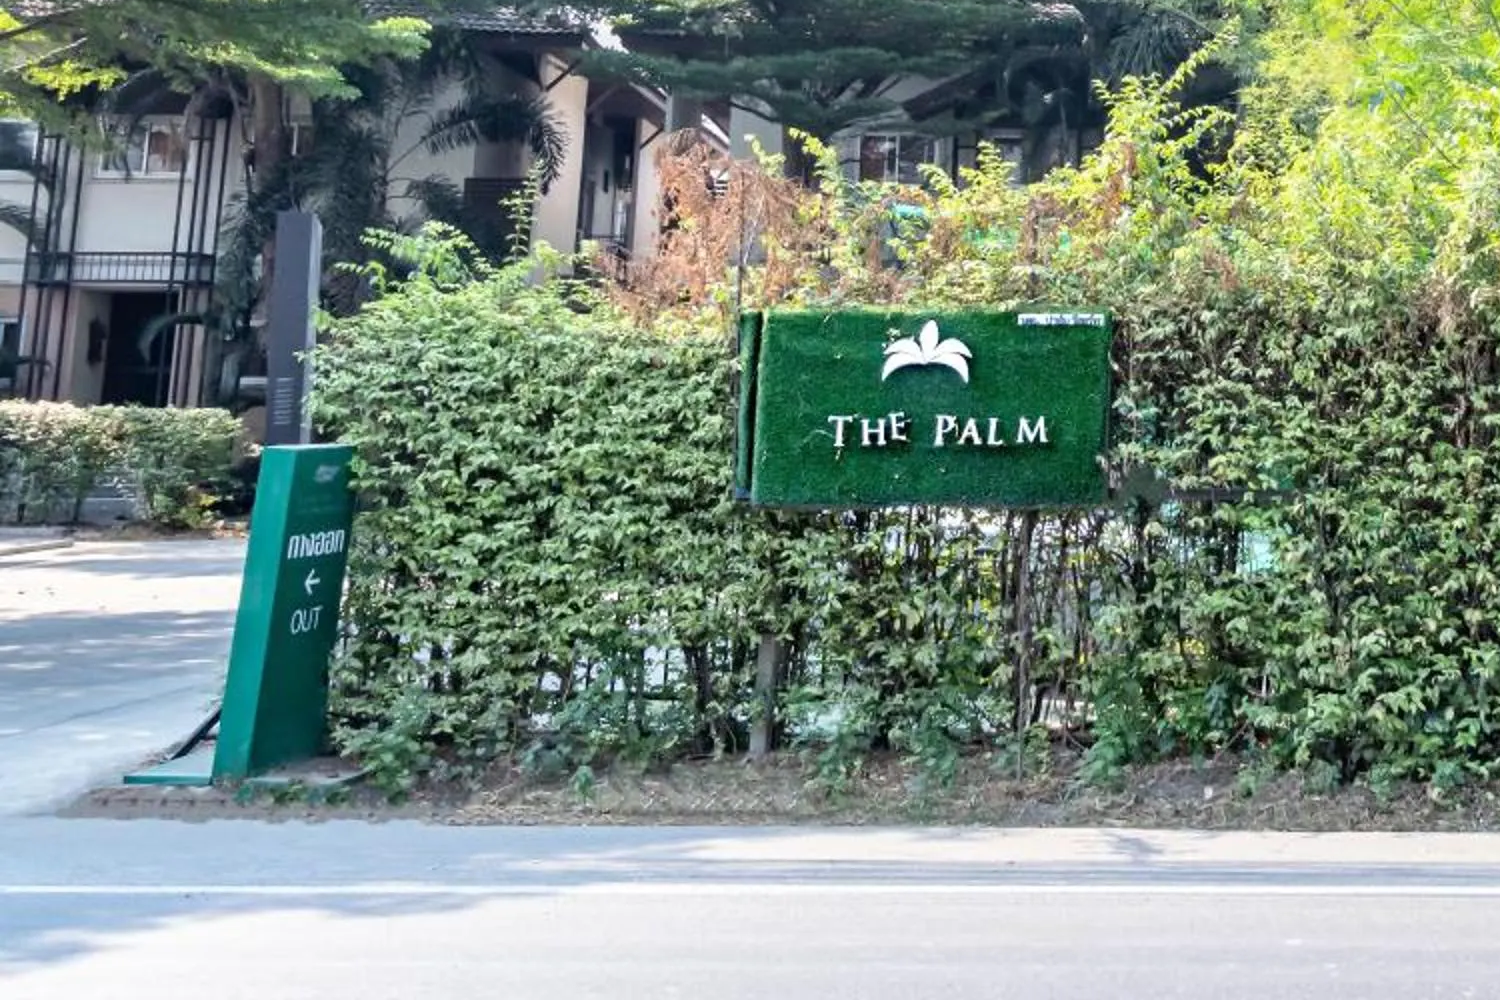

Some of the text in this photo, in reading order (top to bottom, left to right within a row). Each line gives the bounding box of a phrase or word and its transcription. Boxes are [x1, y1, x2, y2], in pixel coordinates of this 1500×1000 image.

[827, 411, 1050, 448] THE PALM
[290, 605, 324, 635] OUT
